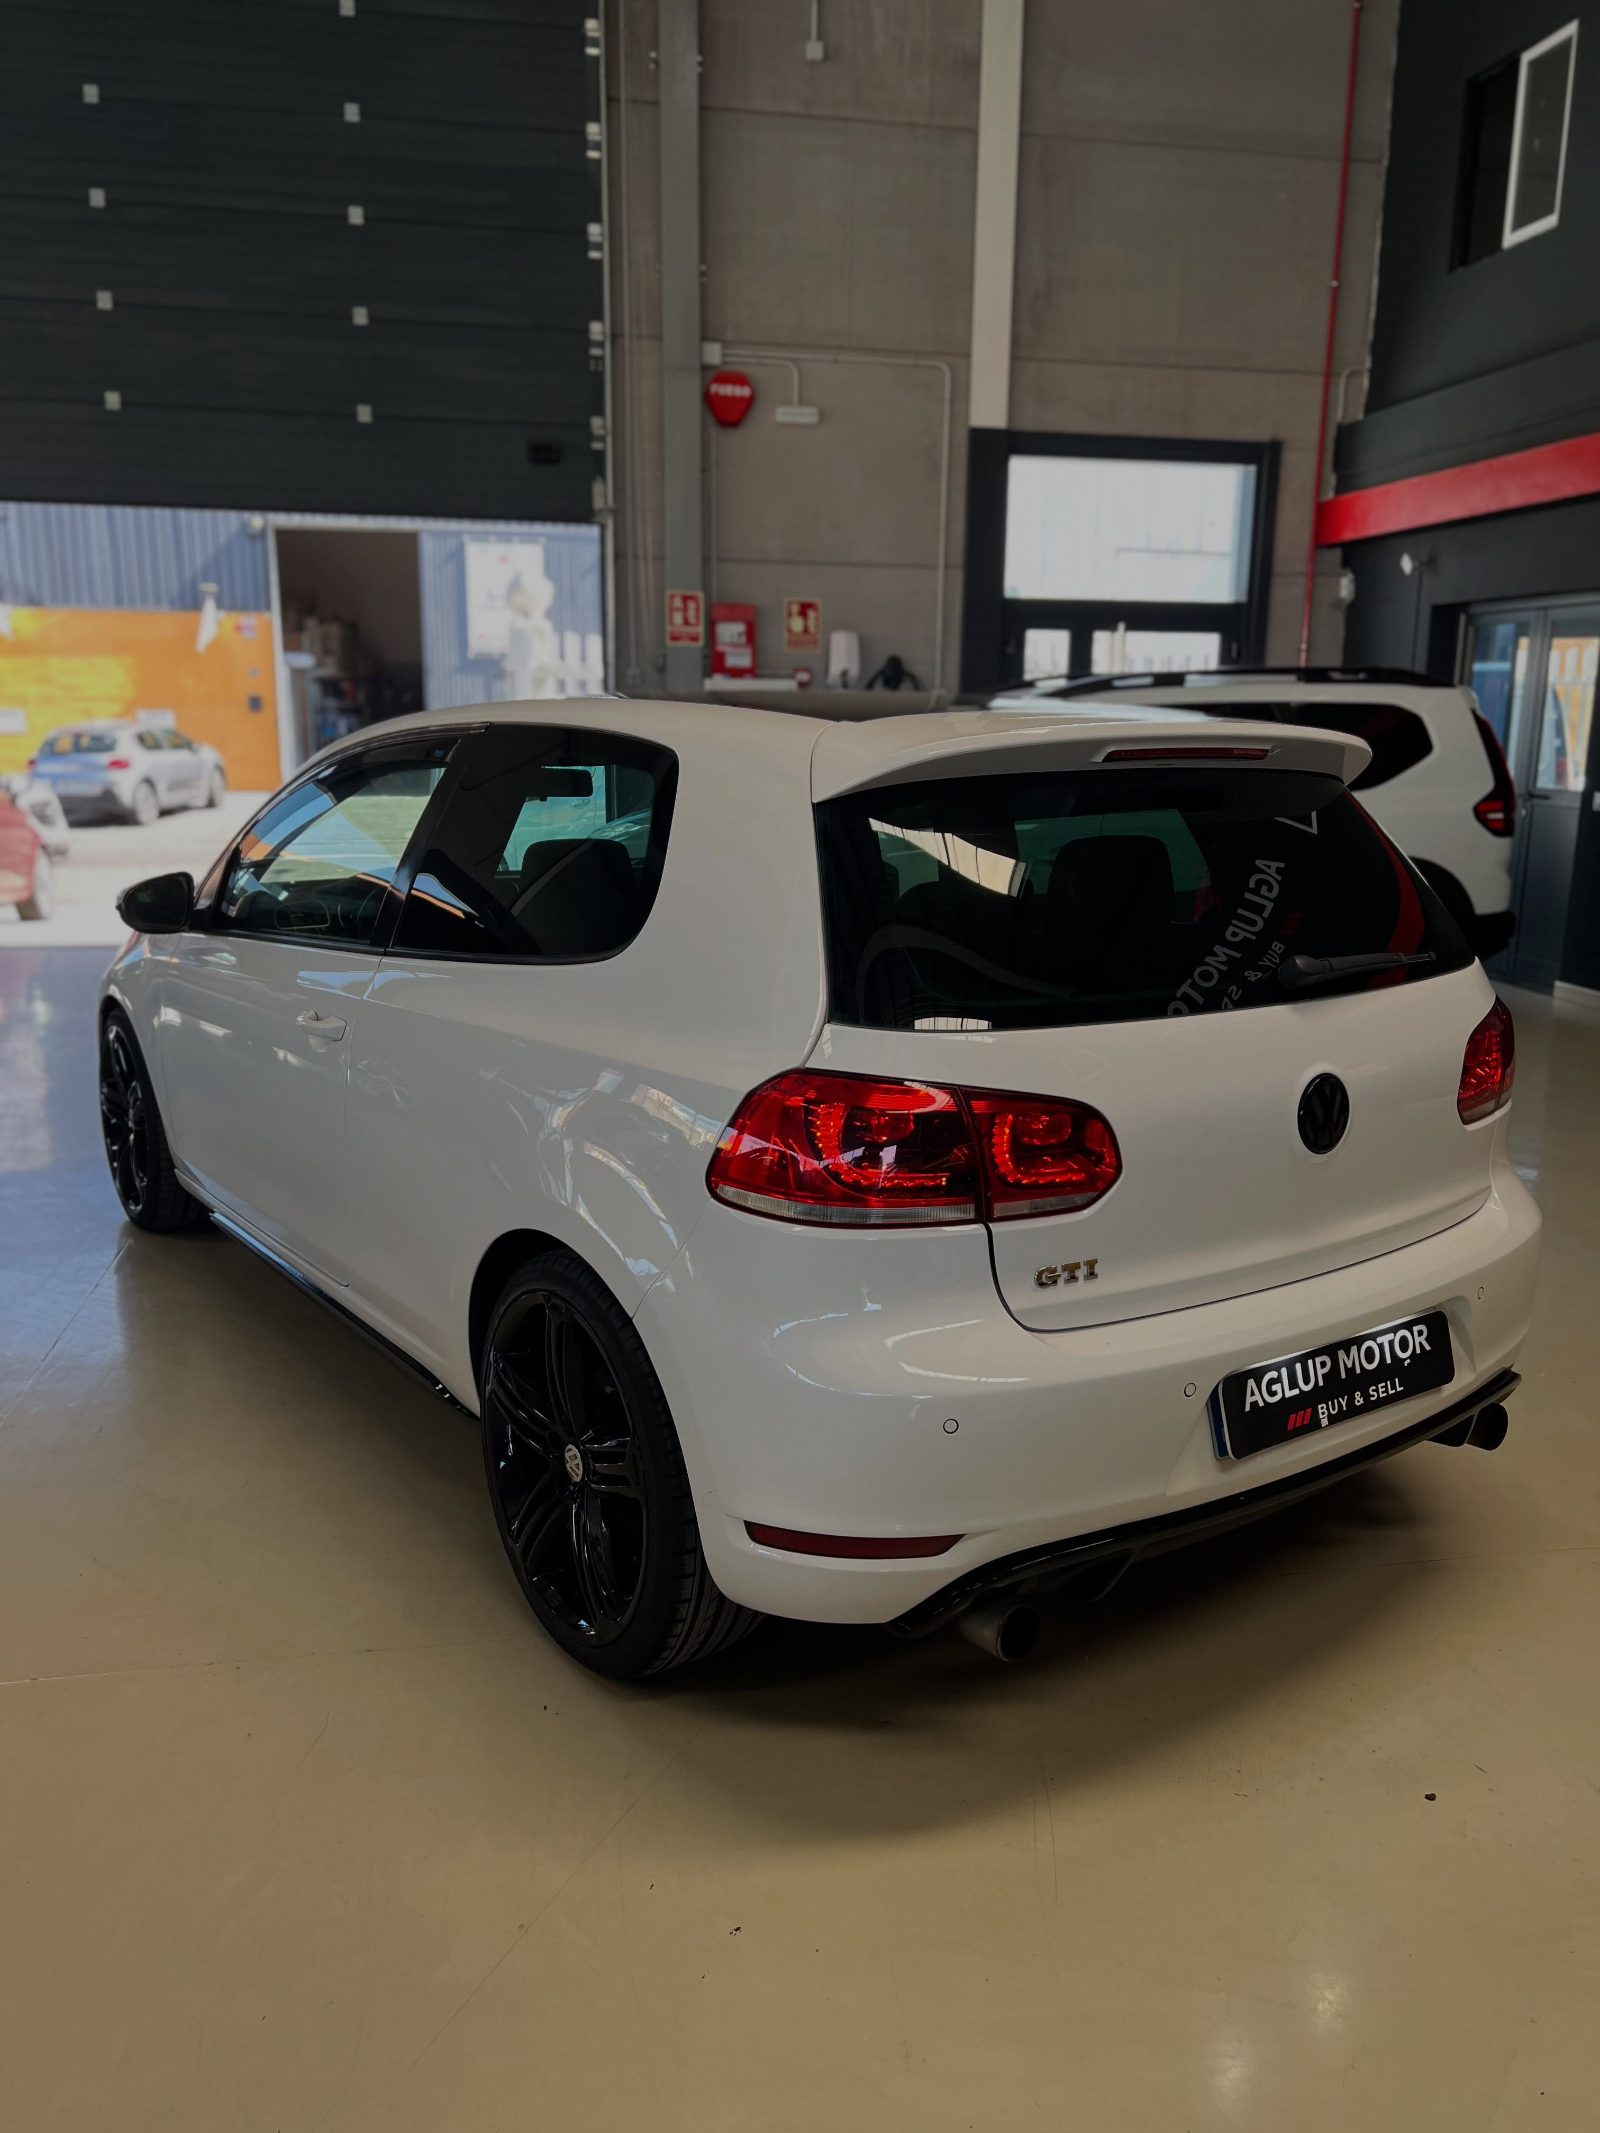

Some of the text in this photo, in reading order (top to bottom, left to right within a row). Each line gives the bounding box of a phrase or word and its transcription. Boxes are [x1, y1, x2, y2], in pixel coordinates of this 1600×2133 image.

[1034, 1258, 1099, 1288] GTI
[1244, 1323, 1432, 1412] AGLUP MOTOR
[1317, 1378, 1404, 1419] BUY & SELL
